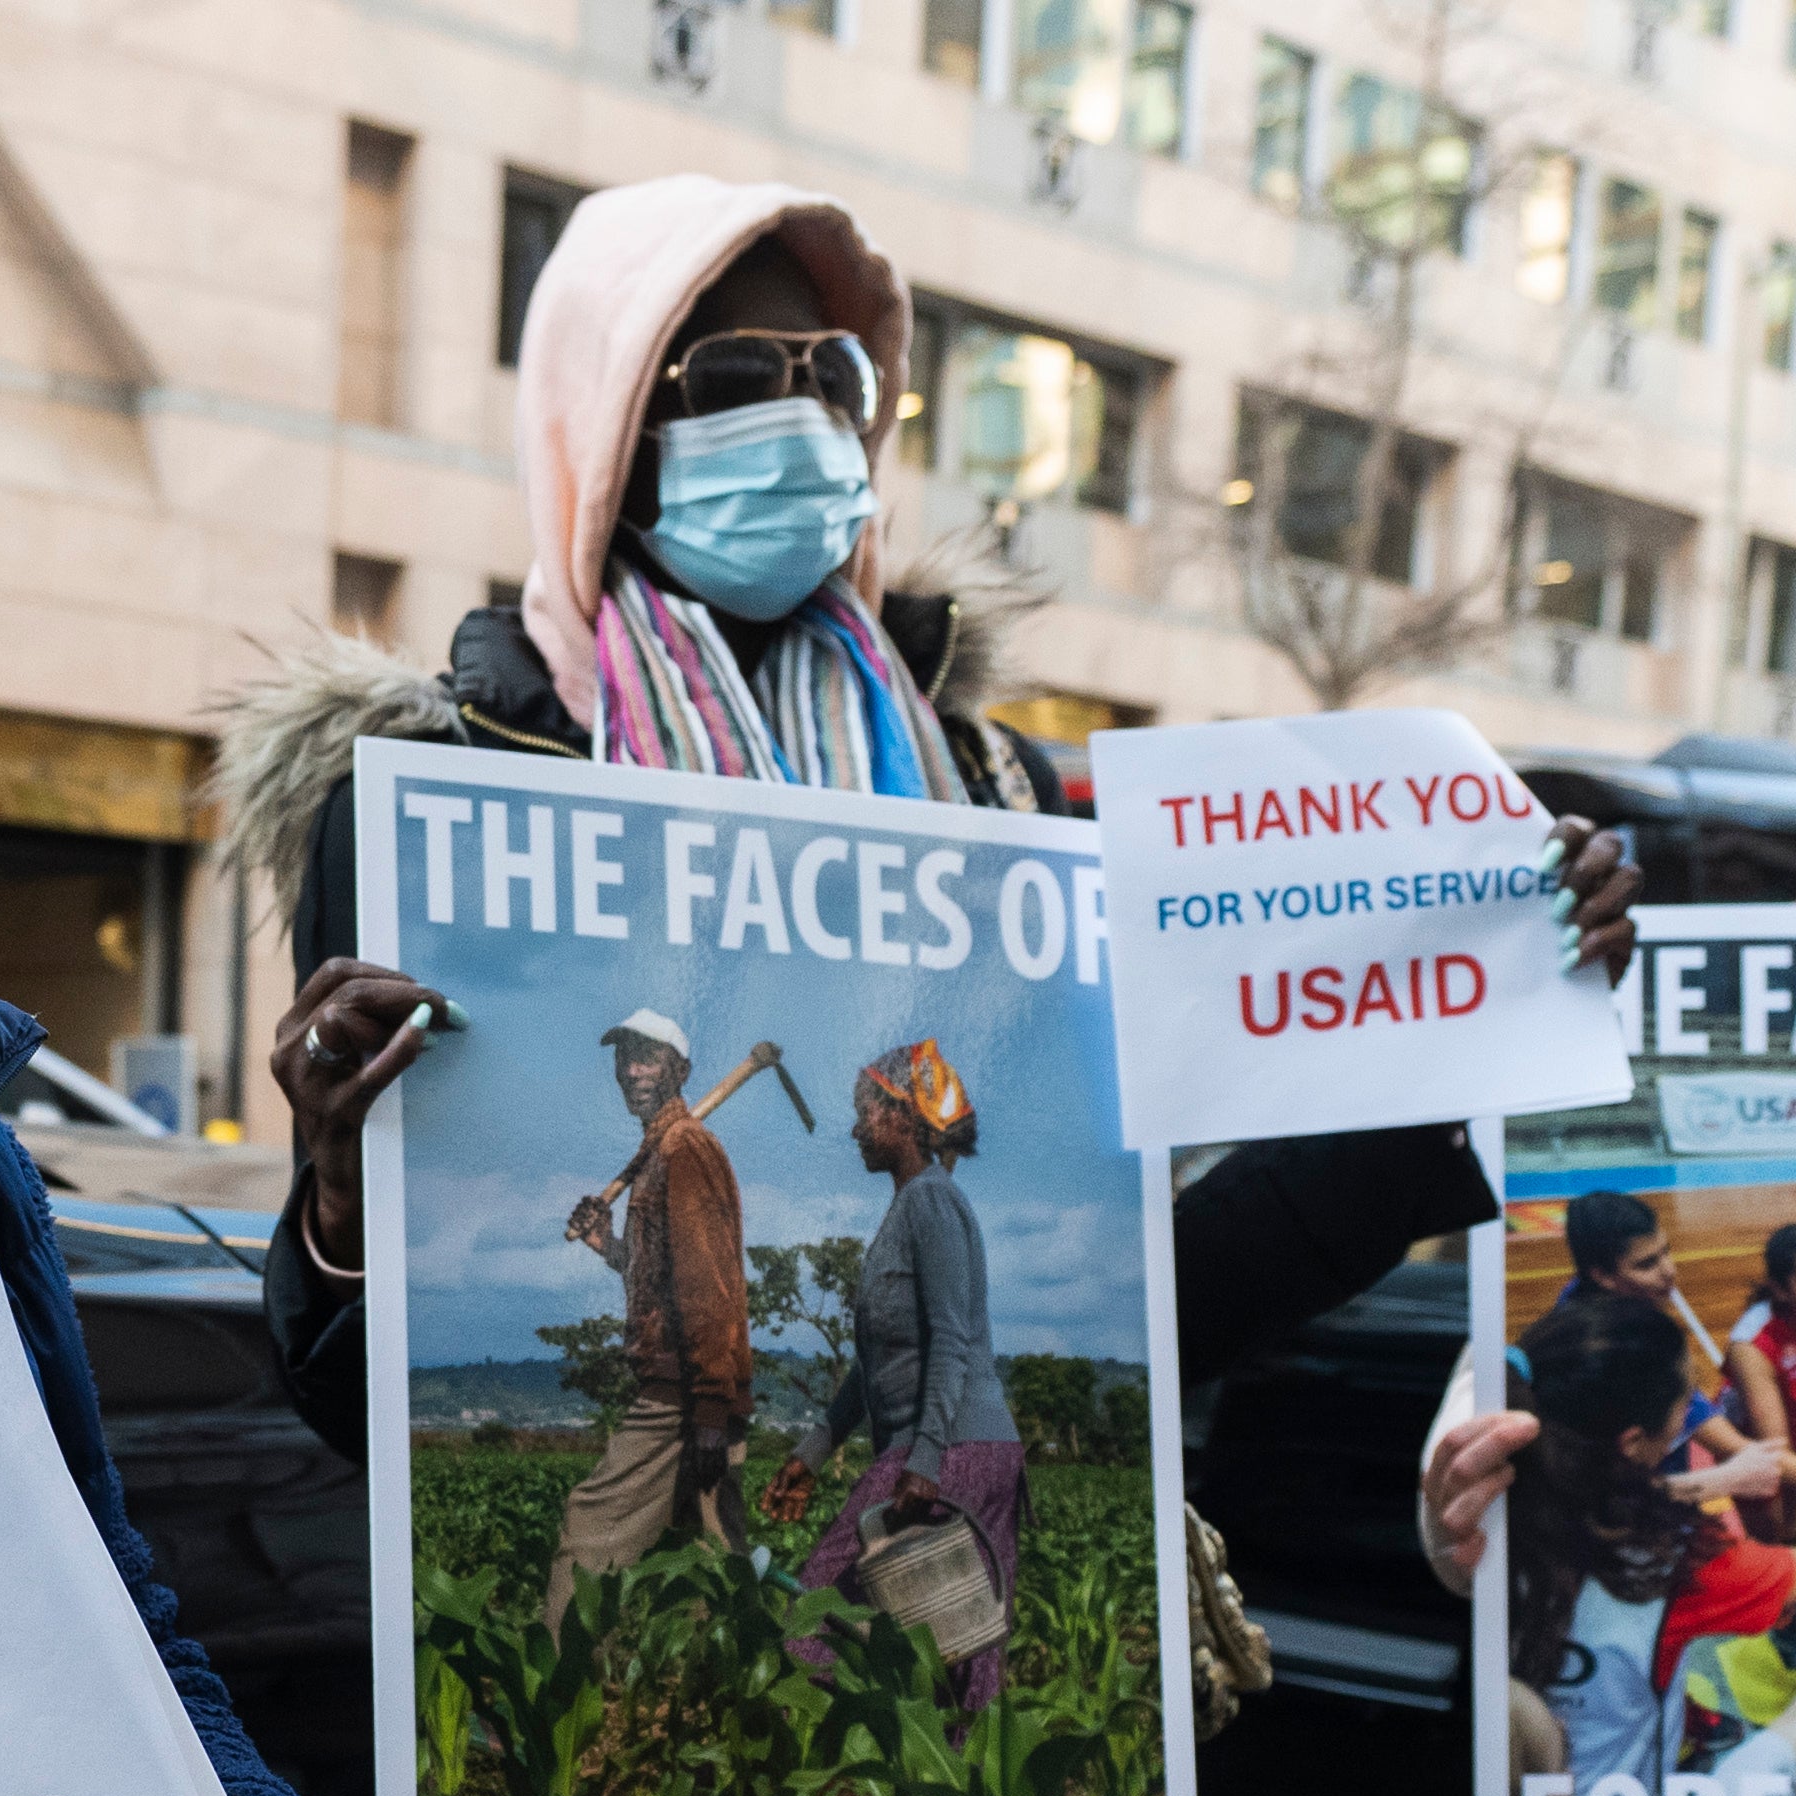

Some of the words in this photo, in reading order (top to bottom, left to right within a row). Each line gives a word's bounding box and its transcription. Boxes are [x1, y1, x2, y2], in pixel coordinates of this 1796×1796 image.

[1159, 780, 1389, 848] THANK
[1403, 772, 1534, 827] YOU
[404, 792, 629, 939] THE
[664, 819, 973, 971] FACES
[999, 859, 1109, 985] OF
[1157, 891, 1245, 932] FOR
[1254, 879, 1374, 922] YOUR
[1385, 865, 1562, 911] SERVICE
[1239, 953, 1487, 1038] USAID
